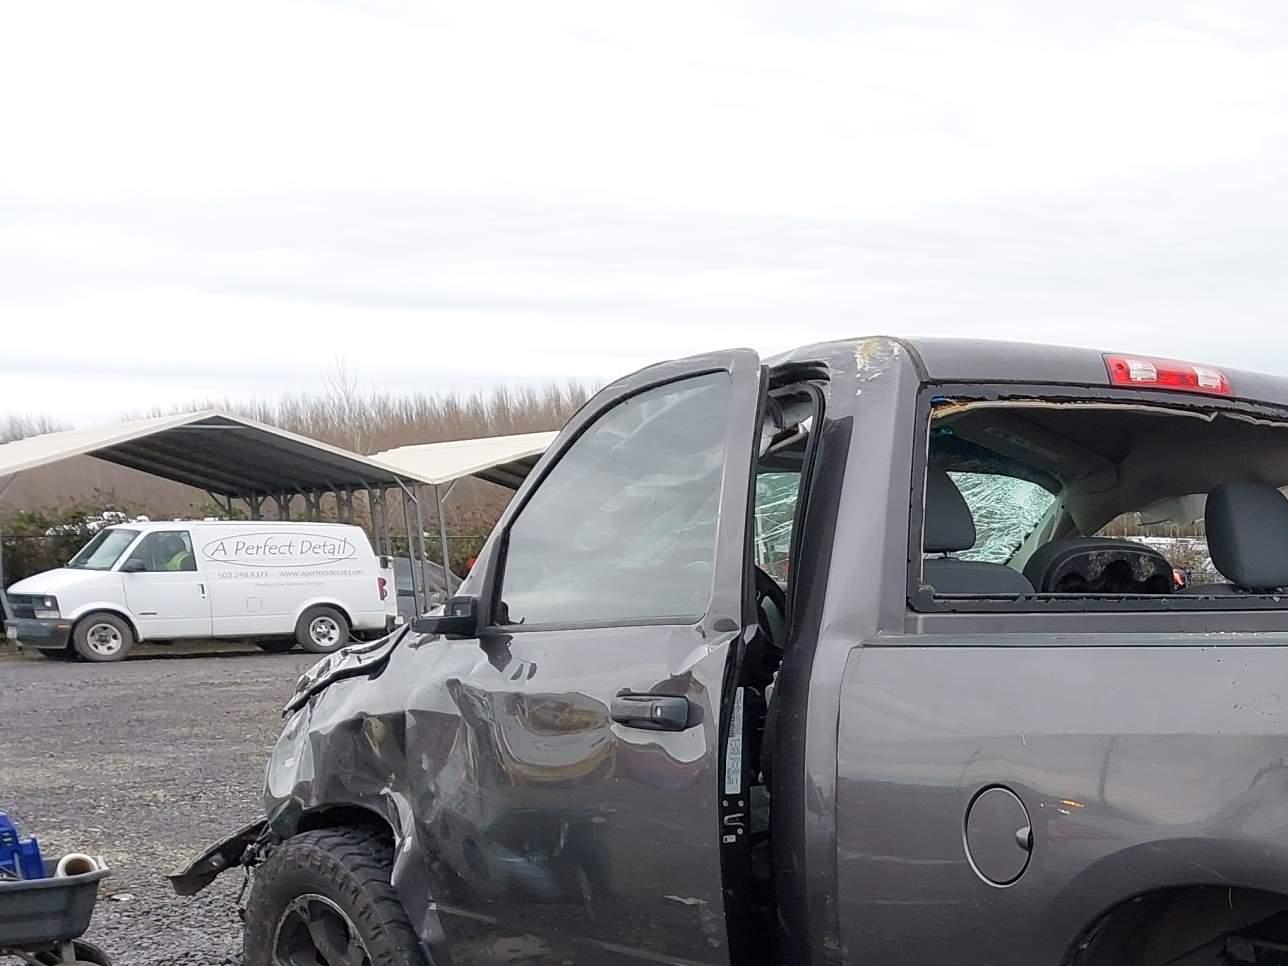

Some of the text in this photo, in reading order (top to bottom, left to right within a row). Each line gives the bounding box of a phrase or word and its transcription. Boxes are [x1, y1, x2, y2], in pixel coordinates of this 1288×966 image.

[210, 536, 347, 556] A Perfect Detail
